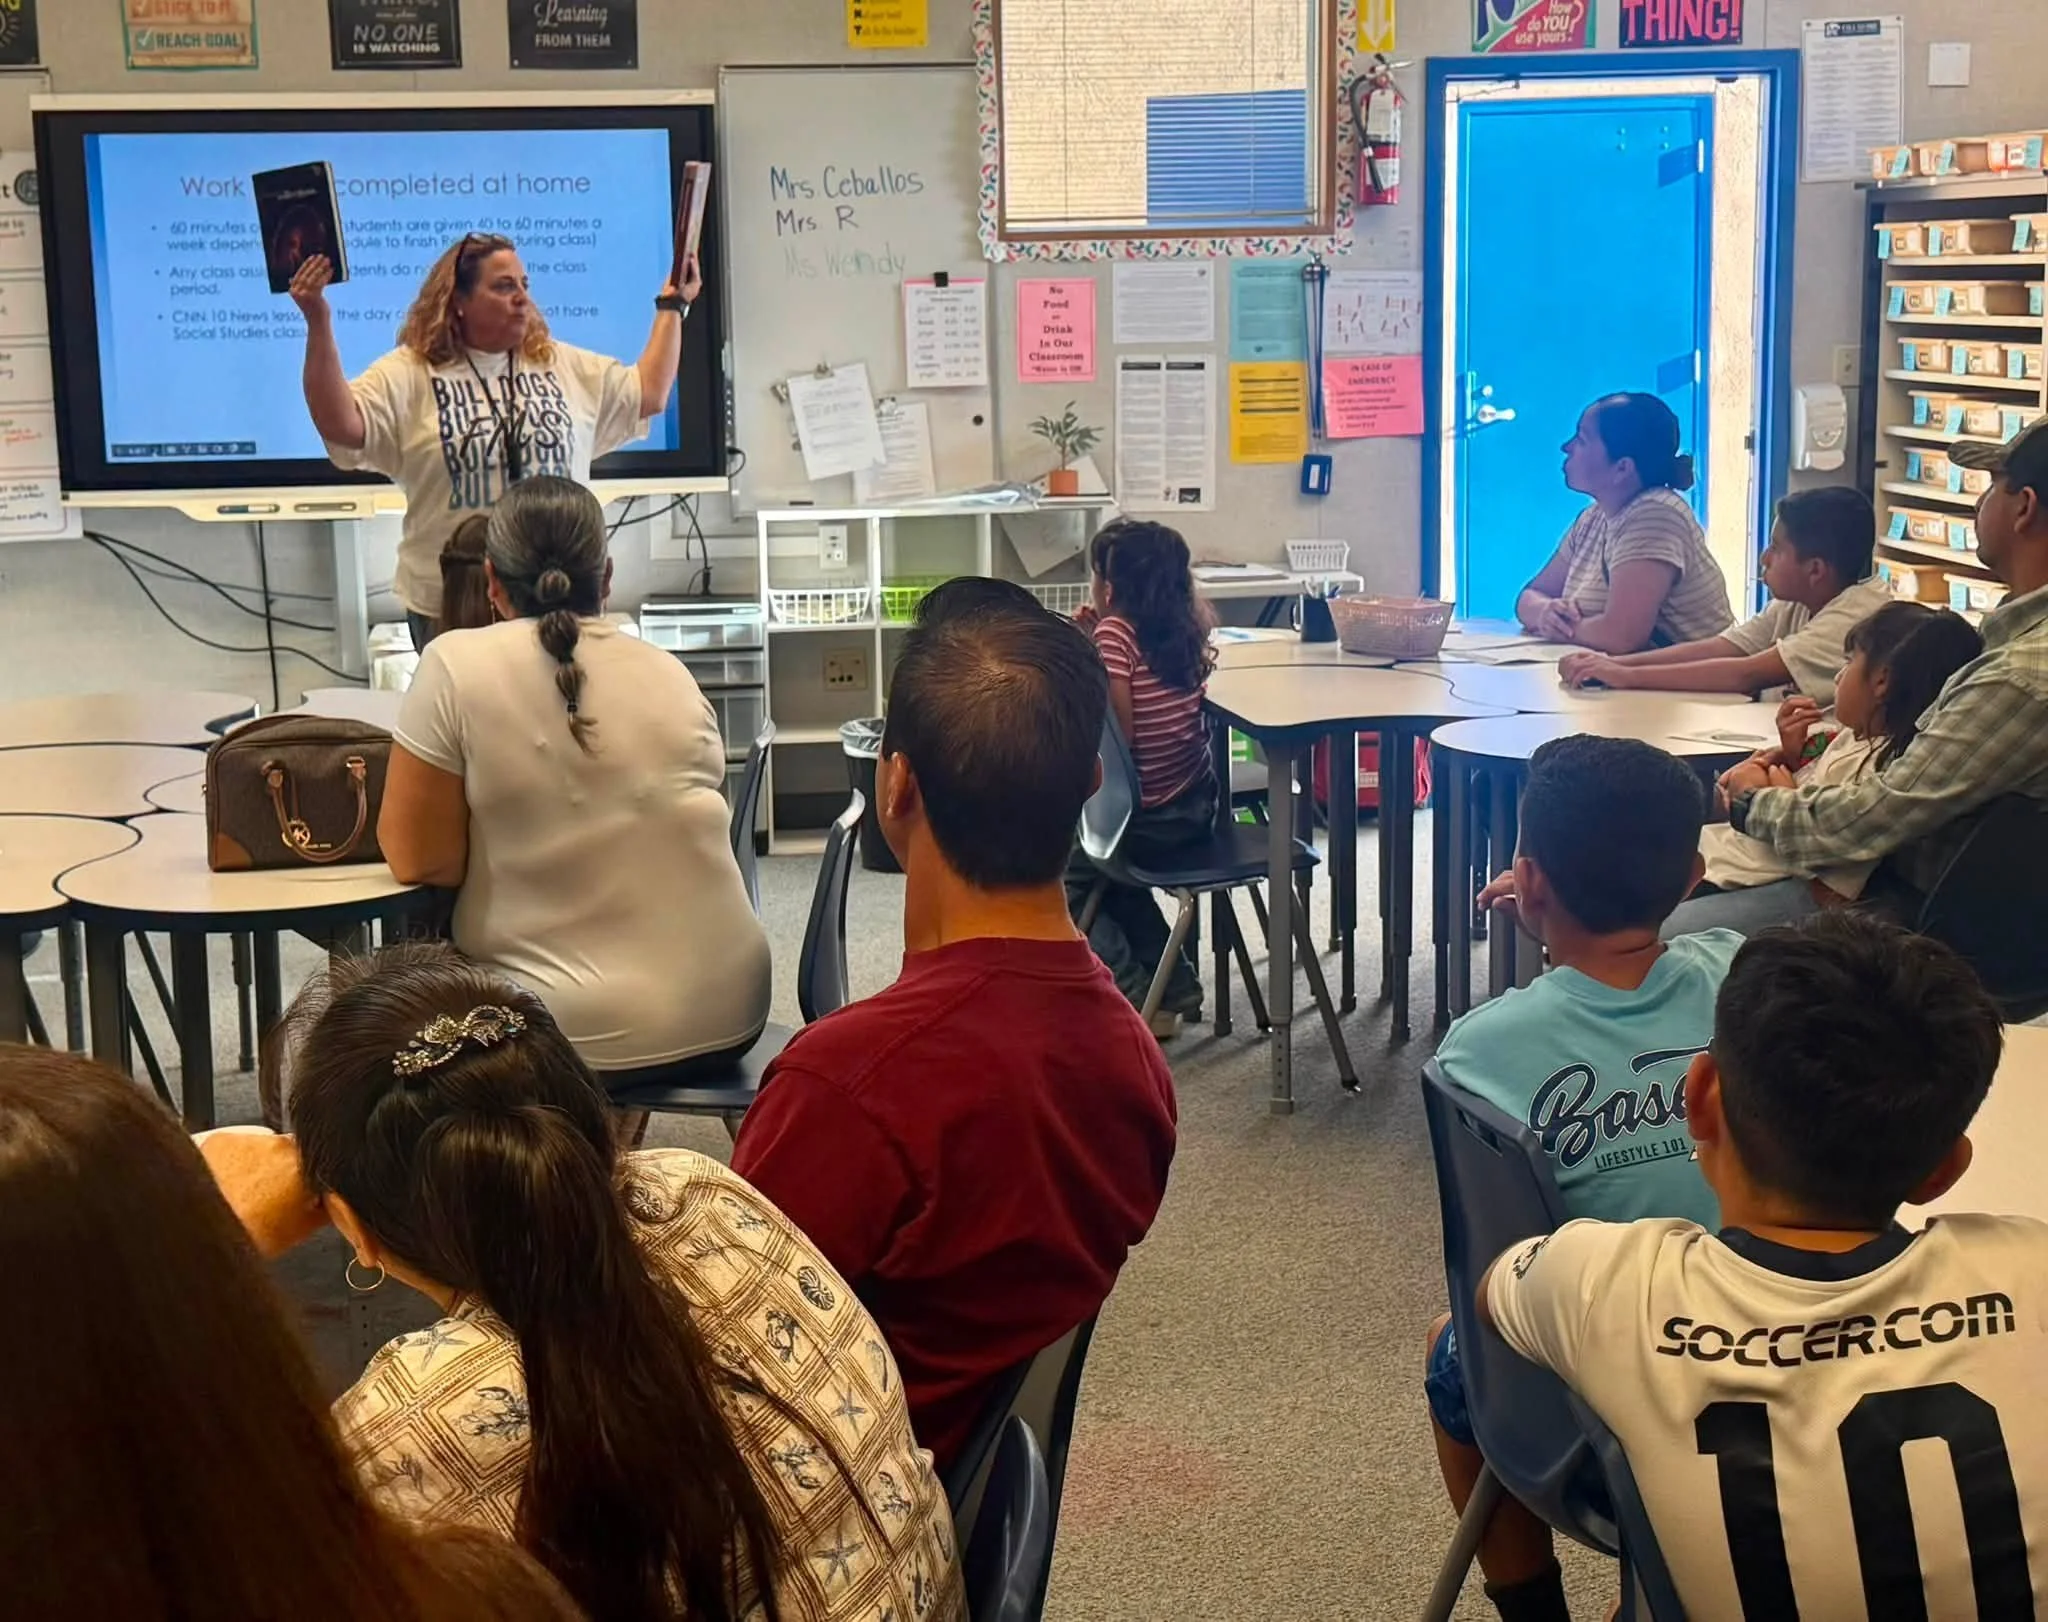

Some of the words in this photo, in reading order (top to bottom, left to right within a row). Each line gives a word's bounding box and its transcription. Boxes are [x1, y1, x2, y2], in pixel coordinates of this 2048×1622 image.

[534, 0, 608, 30] Learning
[1543, 15, 1571, 31] YOU
[1621, 0, 1741, 41] THING!
[156, 31, 202, 48] REACH
[353, 24, 387, 42] NO
[393, 23, 440, 42] ONE
[535, 33, 572, 48] FROM
[575, 33, 612, 48] THEM
[353, 43, 366, 54] IS
[369, 42, 440, 54] WATCHING
[180, 176, 246, 198] Work
[483, 174, 507, 195] at
[517, 173, 591, 195] home
[823, 165, 924, 199] Ceballos
[170, 220, 188, 235] 60
[190, 220, 247, 235] minutes
[406, 221, 430, 232] are
[434, 217, 473, 236] given
[497, 217, 511, 230] to
[514, 216, 531, 231] 60
[534, 216, 588, 230] minutes
[835, 205, 860, 231] R
[166, 238, 207, 251] week
[385, 235, 400, 248] to
[403, 234, 437, 248] finish
[169, 265, 199, 282] Any
[201, 264, 236, 279] class
[391, 262, 410, 276] do
[527, 261, 550, 274] the
[552, 260, 587, 274] class
[1049, 286, 1064, 296] No
[1043, 300, 1070, 309] Food
[230, 308, 269, 322] News
[337, 307, 360, 321] the
[363, 306, 391, 324] day
[562, 304, 599, 318] have
[172, 325, 216, 341] Social
[219, 325, 270, 341] Studies
[1043, 325, 1073, 335] Drink
[1053, 338, 1074, 348] Our
[1029, 352, 1084, 362] Classroom
[1361, 362, 1381, 372] CASE
[1594, 1142, 1661, 1170] LIFESTYLE
[1663, 1136, 1688, 1155] 101
[1656, 1291, 2018, 1368] SOCCER.COM
[1694, 1381, 2036, 1622] 10
